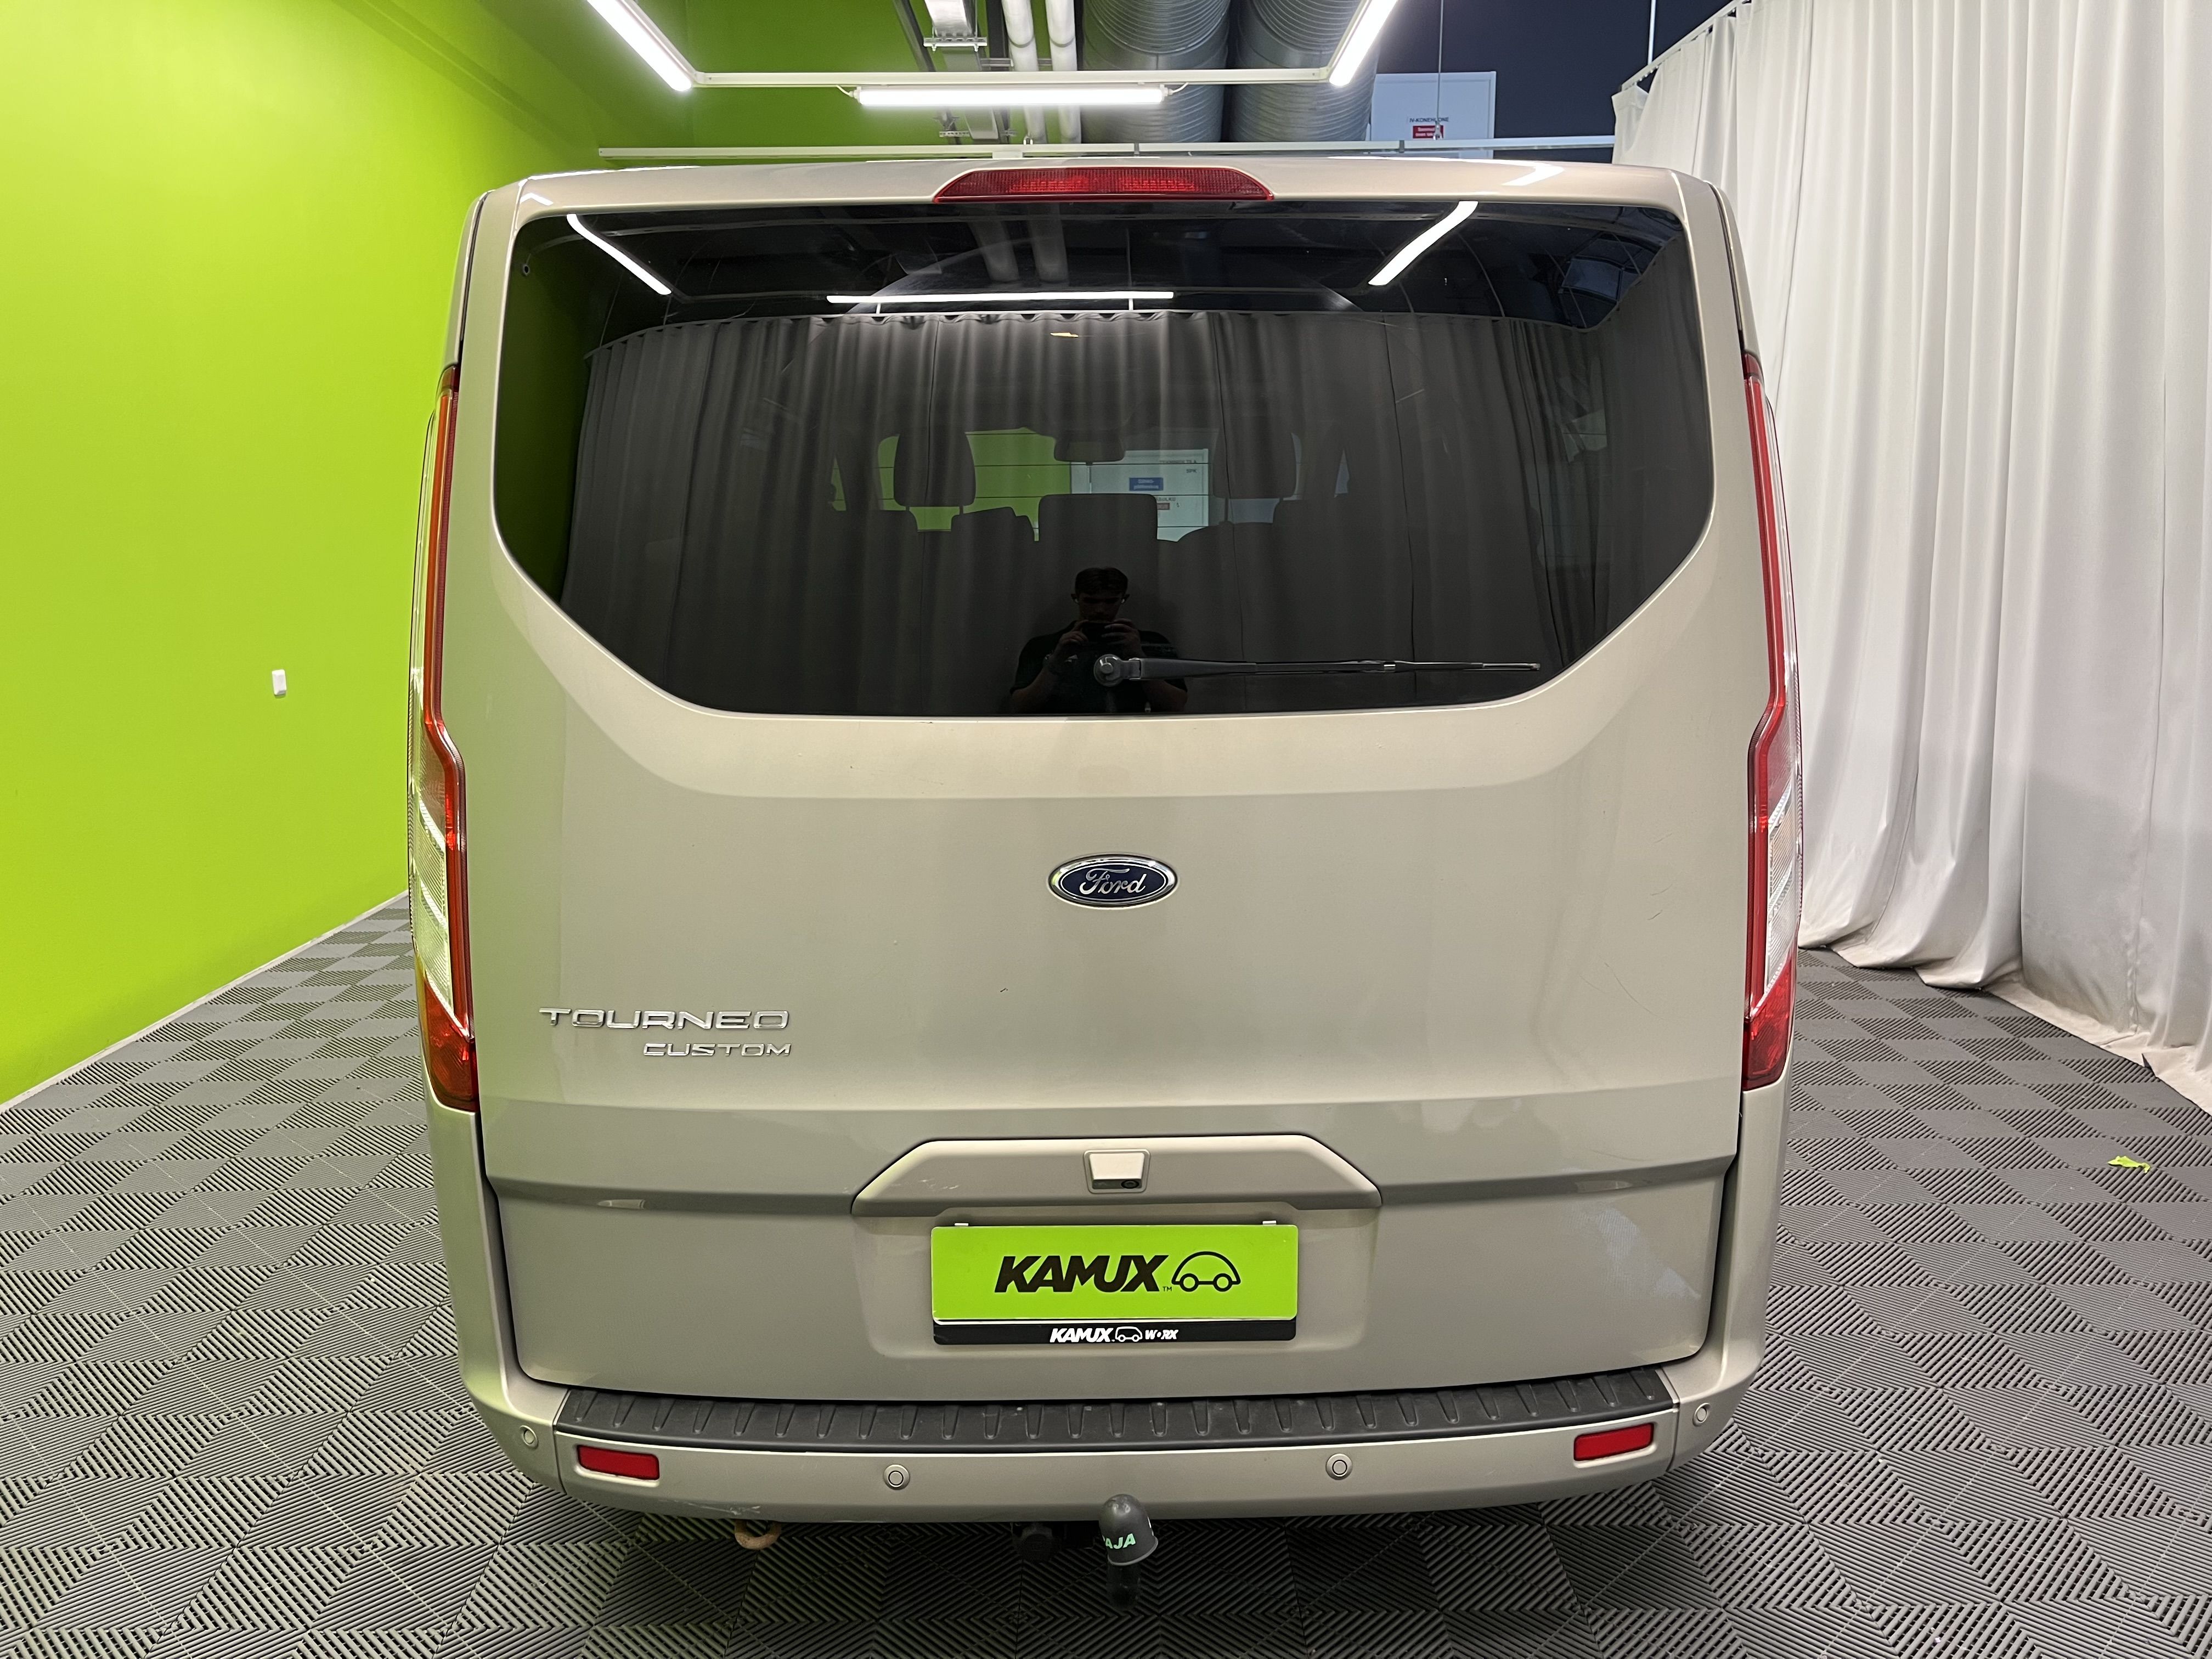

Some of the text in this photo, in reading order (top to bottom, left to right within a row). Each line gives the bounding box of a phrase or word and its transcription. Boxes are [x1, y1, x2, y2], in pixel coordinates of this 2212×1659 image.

[1079, 868, 1147, 895] Ford
[539, 1007, 789, 1029] TOURNEO
[644, 1043, 792, 1057] CUSTOM
[994, 1255, 1169, 1293] KAMUX
[1049, 1327, 1114, 1343] KAMUX
[1102, 1533, 1136, 1549] AJA
